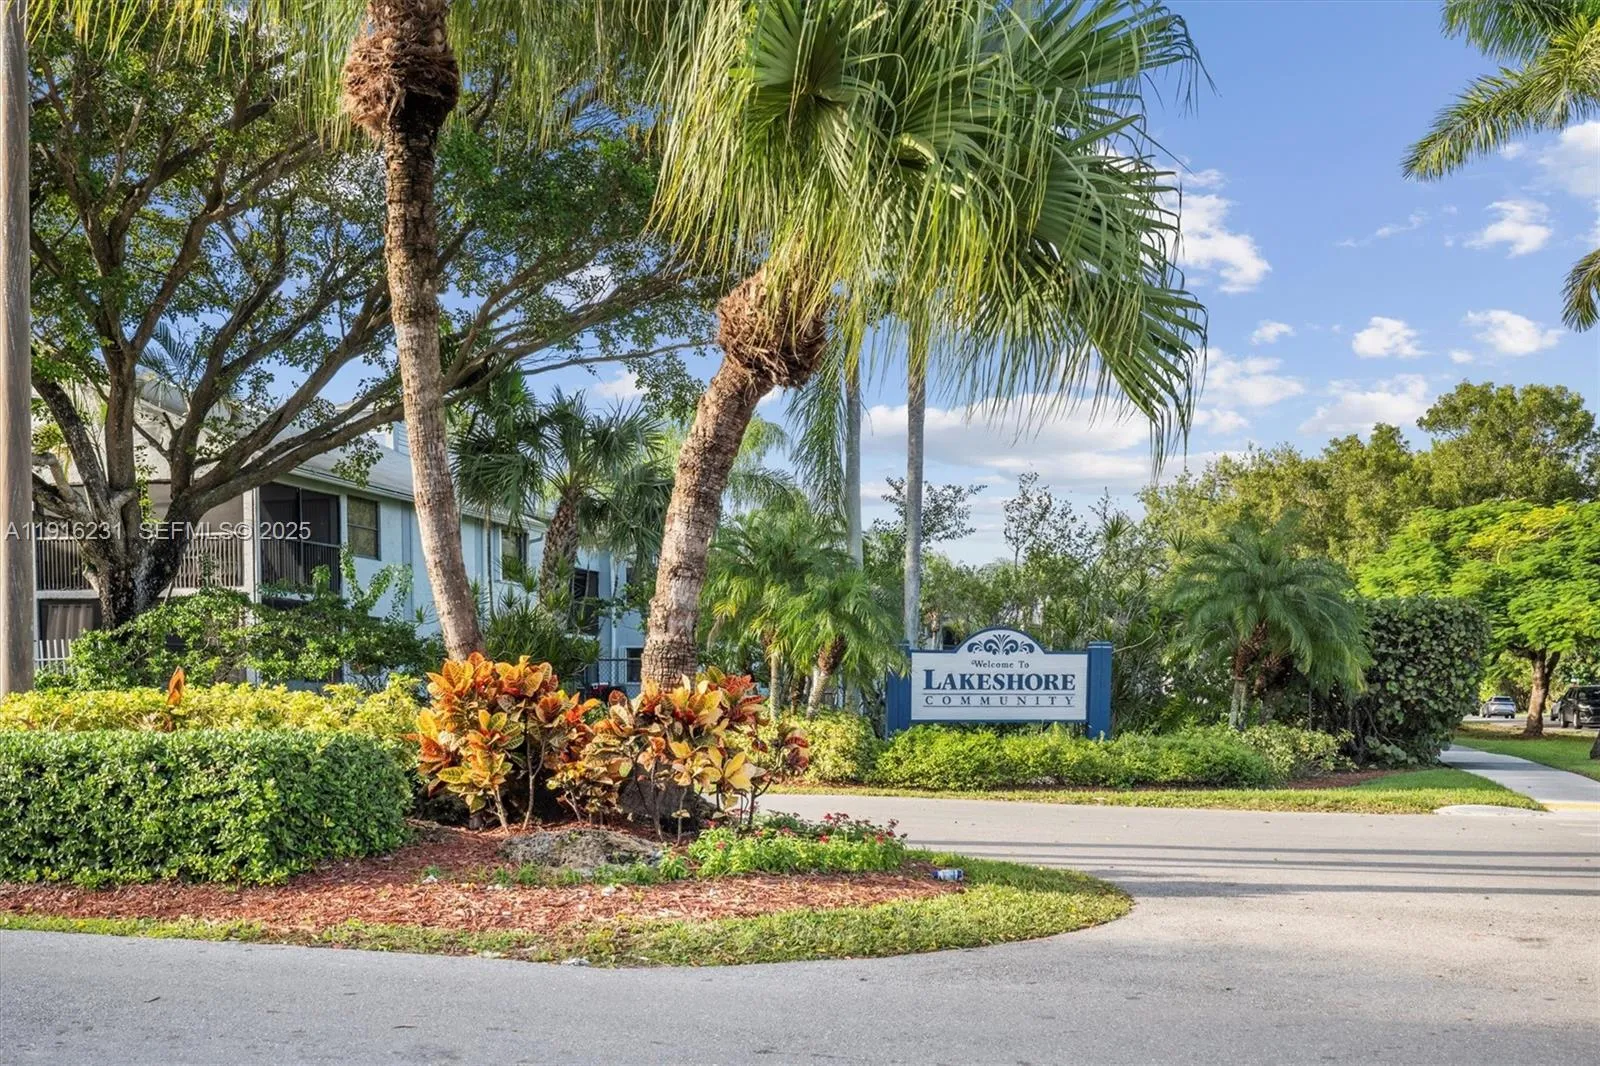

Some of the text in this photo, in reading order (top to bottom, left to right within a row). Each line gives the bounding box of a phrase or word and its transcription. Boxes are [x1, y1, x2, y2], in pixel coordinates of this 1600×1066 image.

[971, 659, 1030, 669] Welcome To
[922, 668, 1076, 691] LAKESHORE
[925, 695, 1074, 706] COMMUNITY
